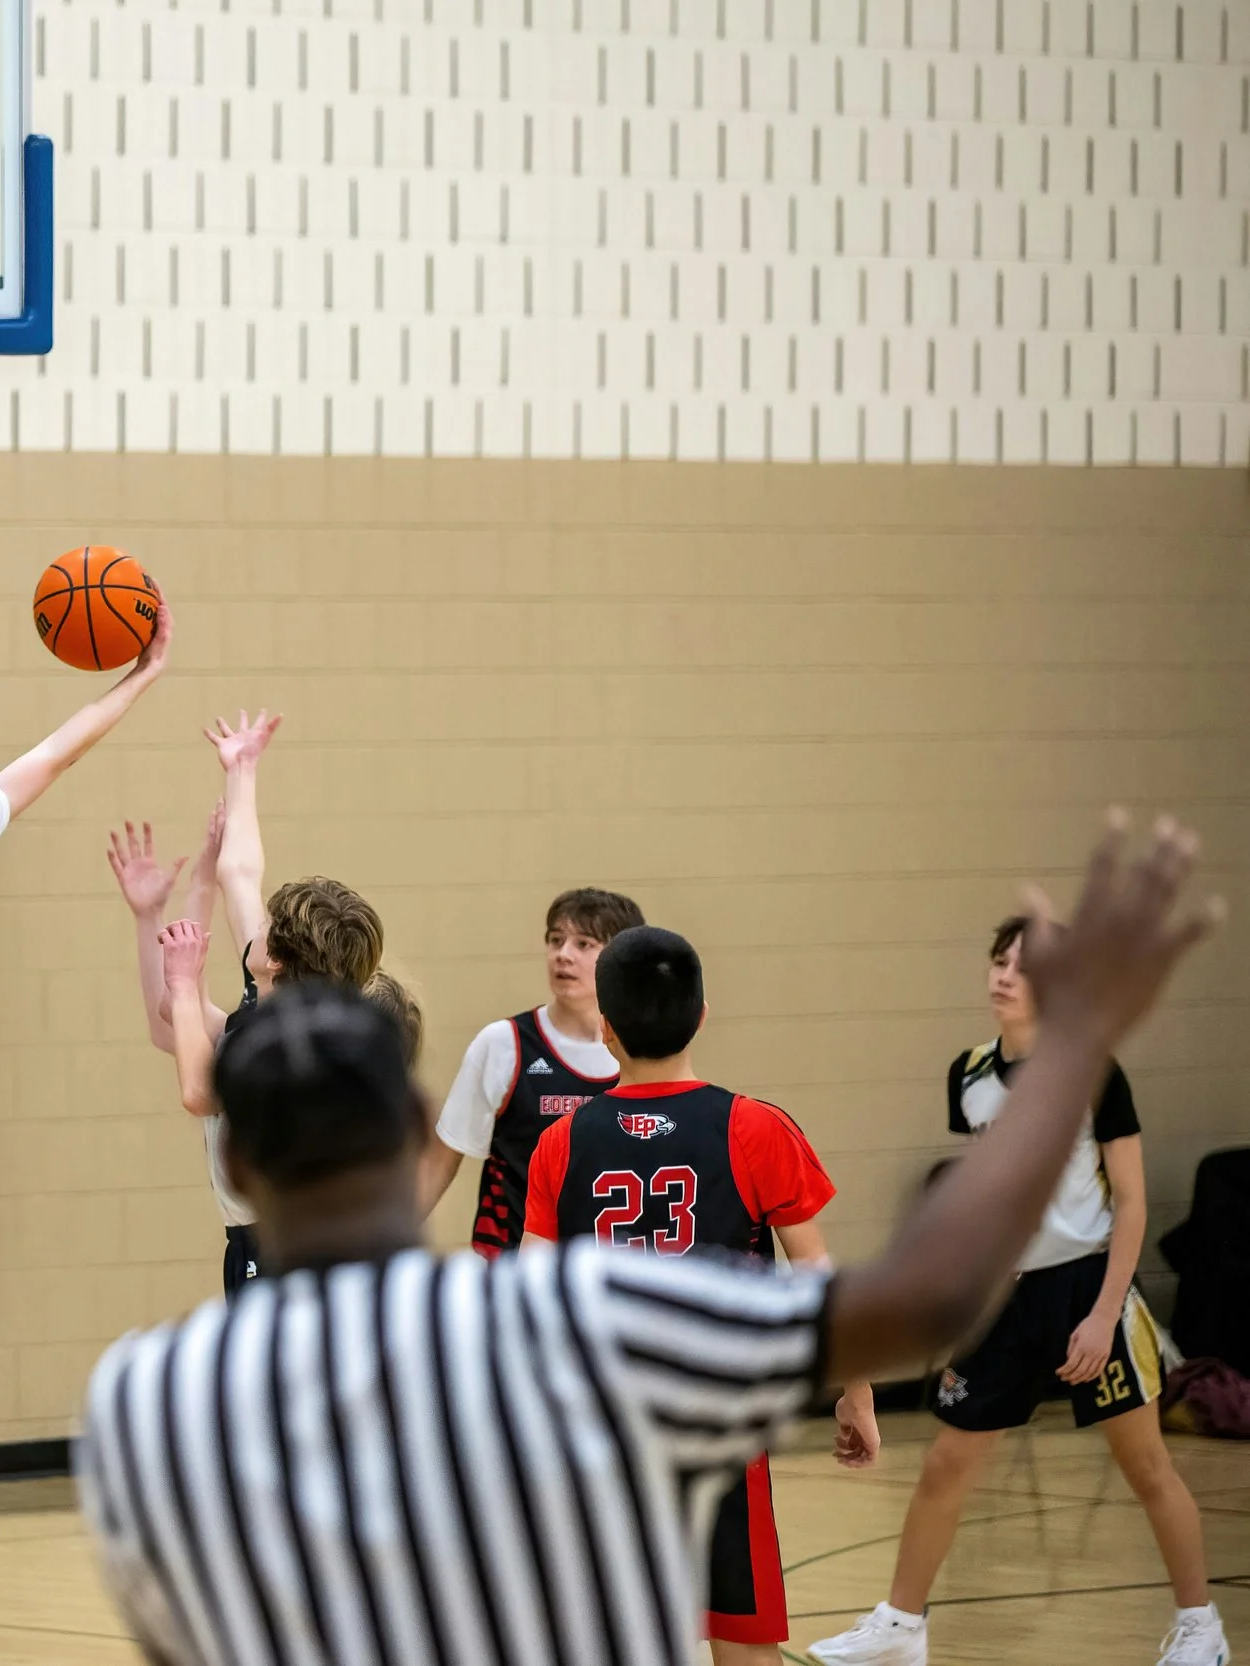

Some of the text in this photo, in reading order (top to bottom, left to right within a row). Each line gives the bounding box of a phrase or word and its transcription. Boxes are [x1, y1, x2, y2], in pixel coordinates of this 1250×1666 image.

[631, 1113, 658, 1139] EP
[592, 1165, 698, 1258] 23
[1094, 1360, 1131, 1408] 32
